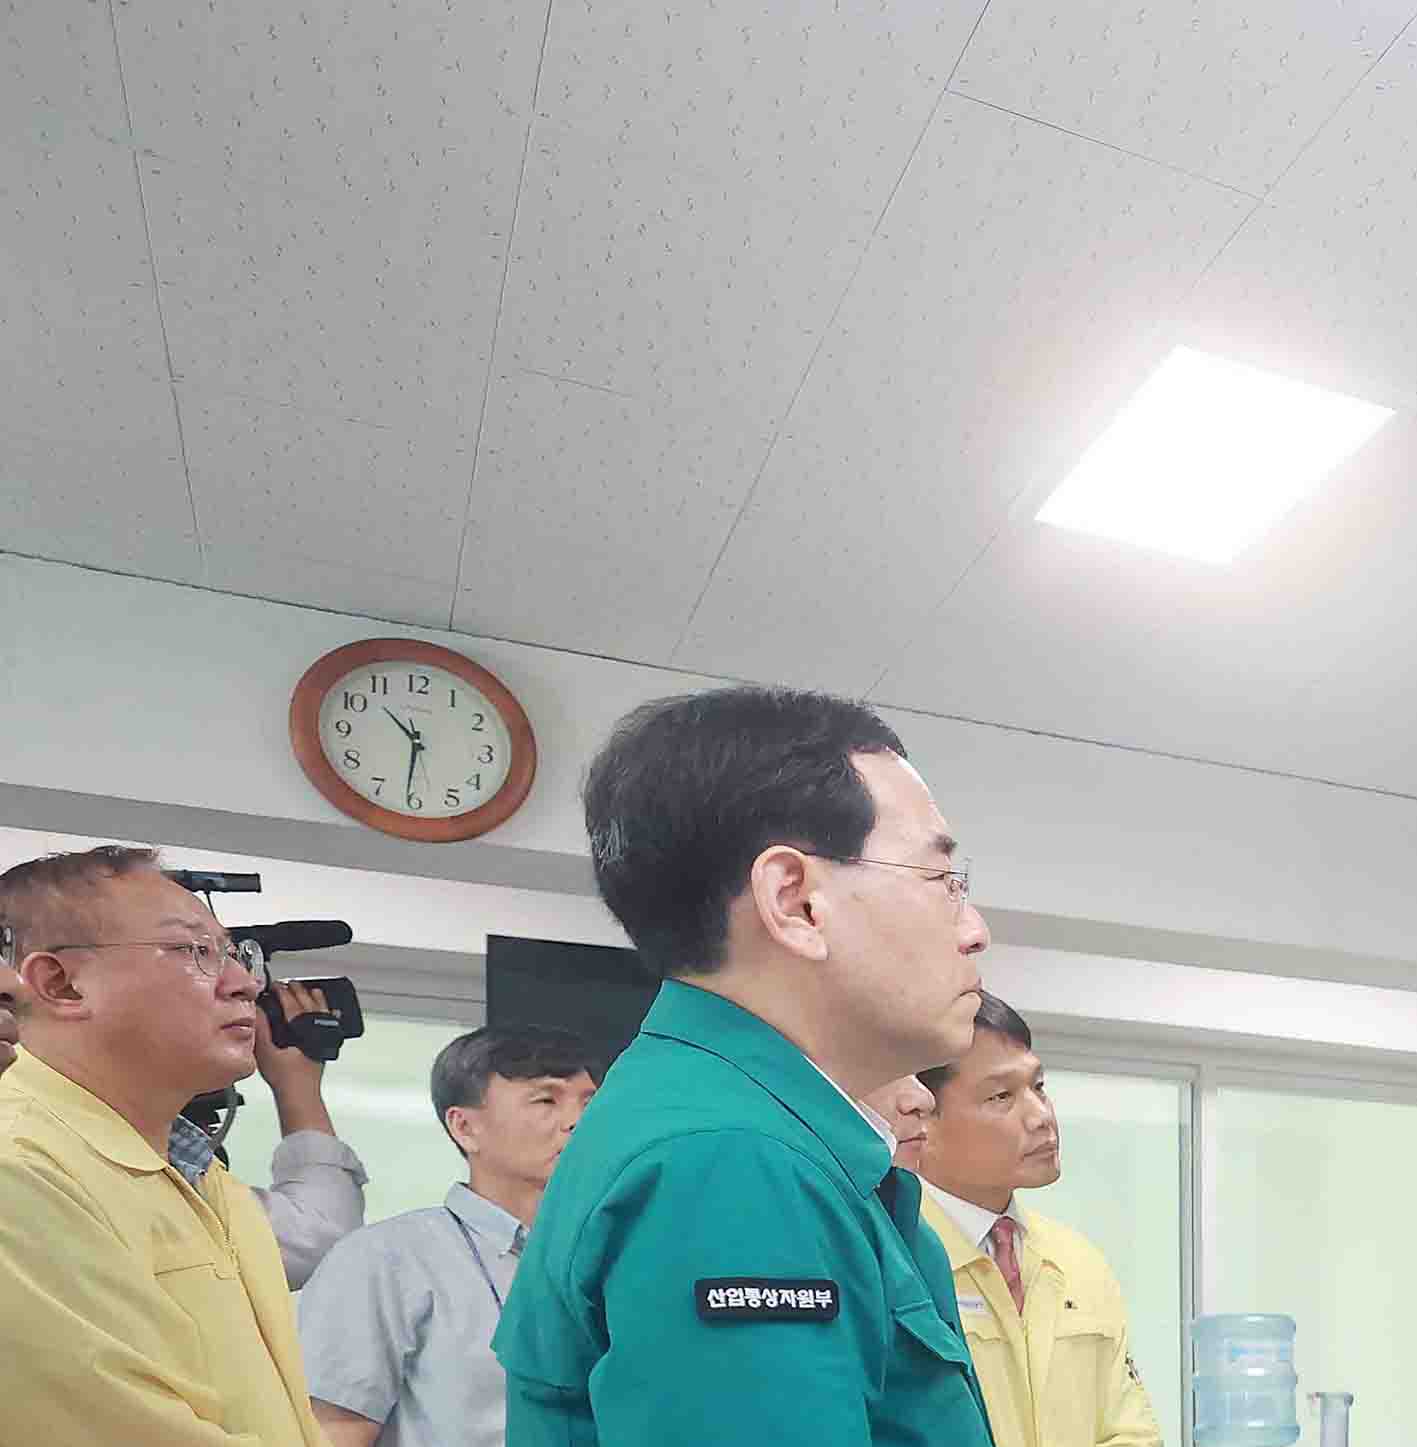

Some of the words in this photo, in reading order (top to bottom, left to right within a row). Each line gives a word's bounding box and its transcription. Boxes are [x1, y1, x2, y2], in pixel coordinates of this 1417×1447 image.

[370, 673, 389, 696] 11
[406, 673, 431, 696] 12
[342, 690, 369, 713] 10
[448, 688, 457, 709] 1
[334, 718, 353, 739] 9
[471, 712, 486, 732] 2
[342, 748, 362, 771] 8
[477, 744, 495, 765] 3
[370, 775, 387, 797] 7
[464, 772, 482, 791] 4
[406, 791, 423, 811] 6
[443, 787, 461, 808] 5
[706, 1286, 834, 1310] 산업통상자원부
